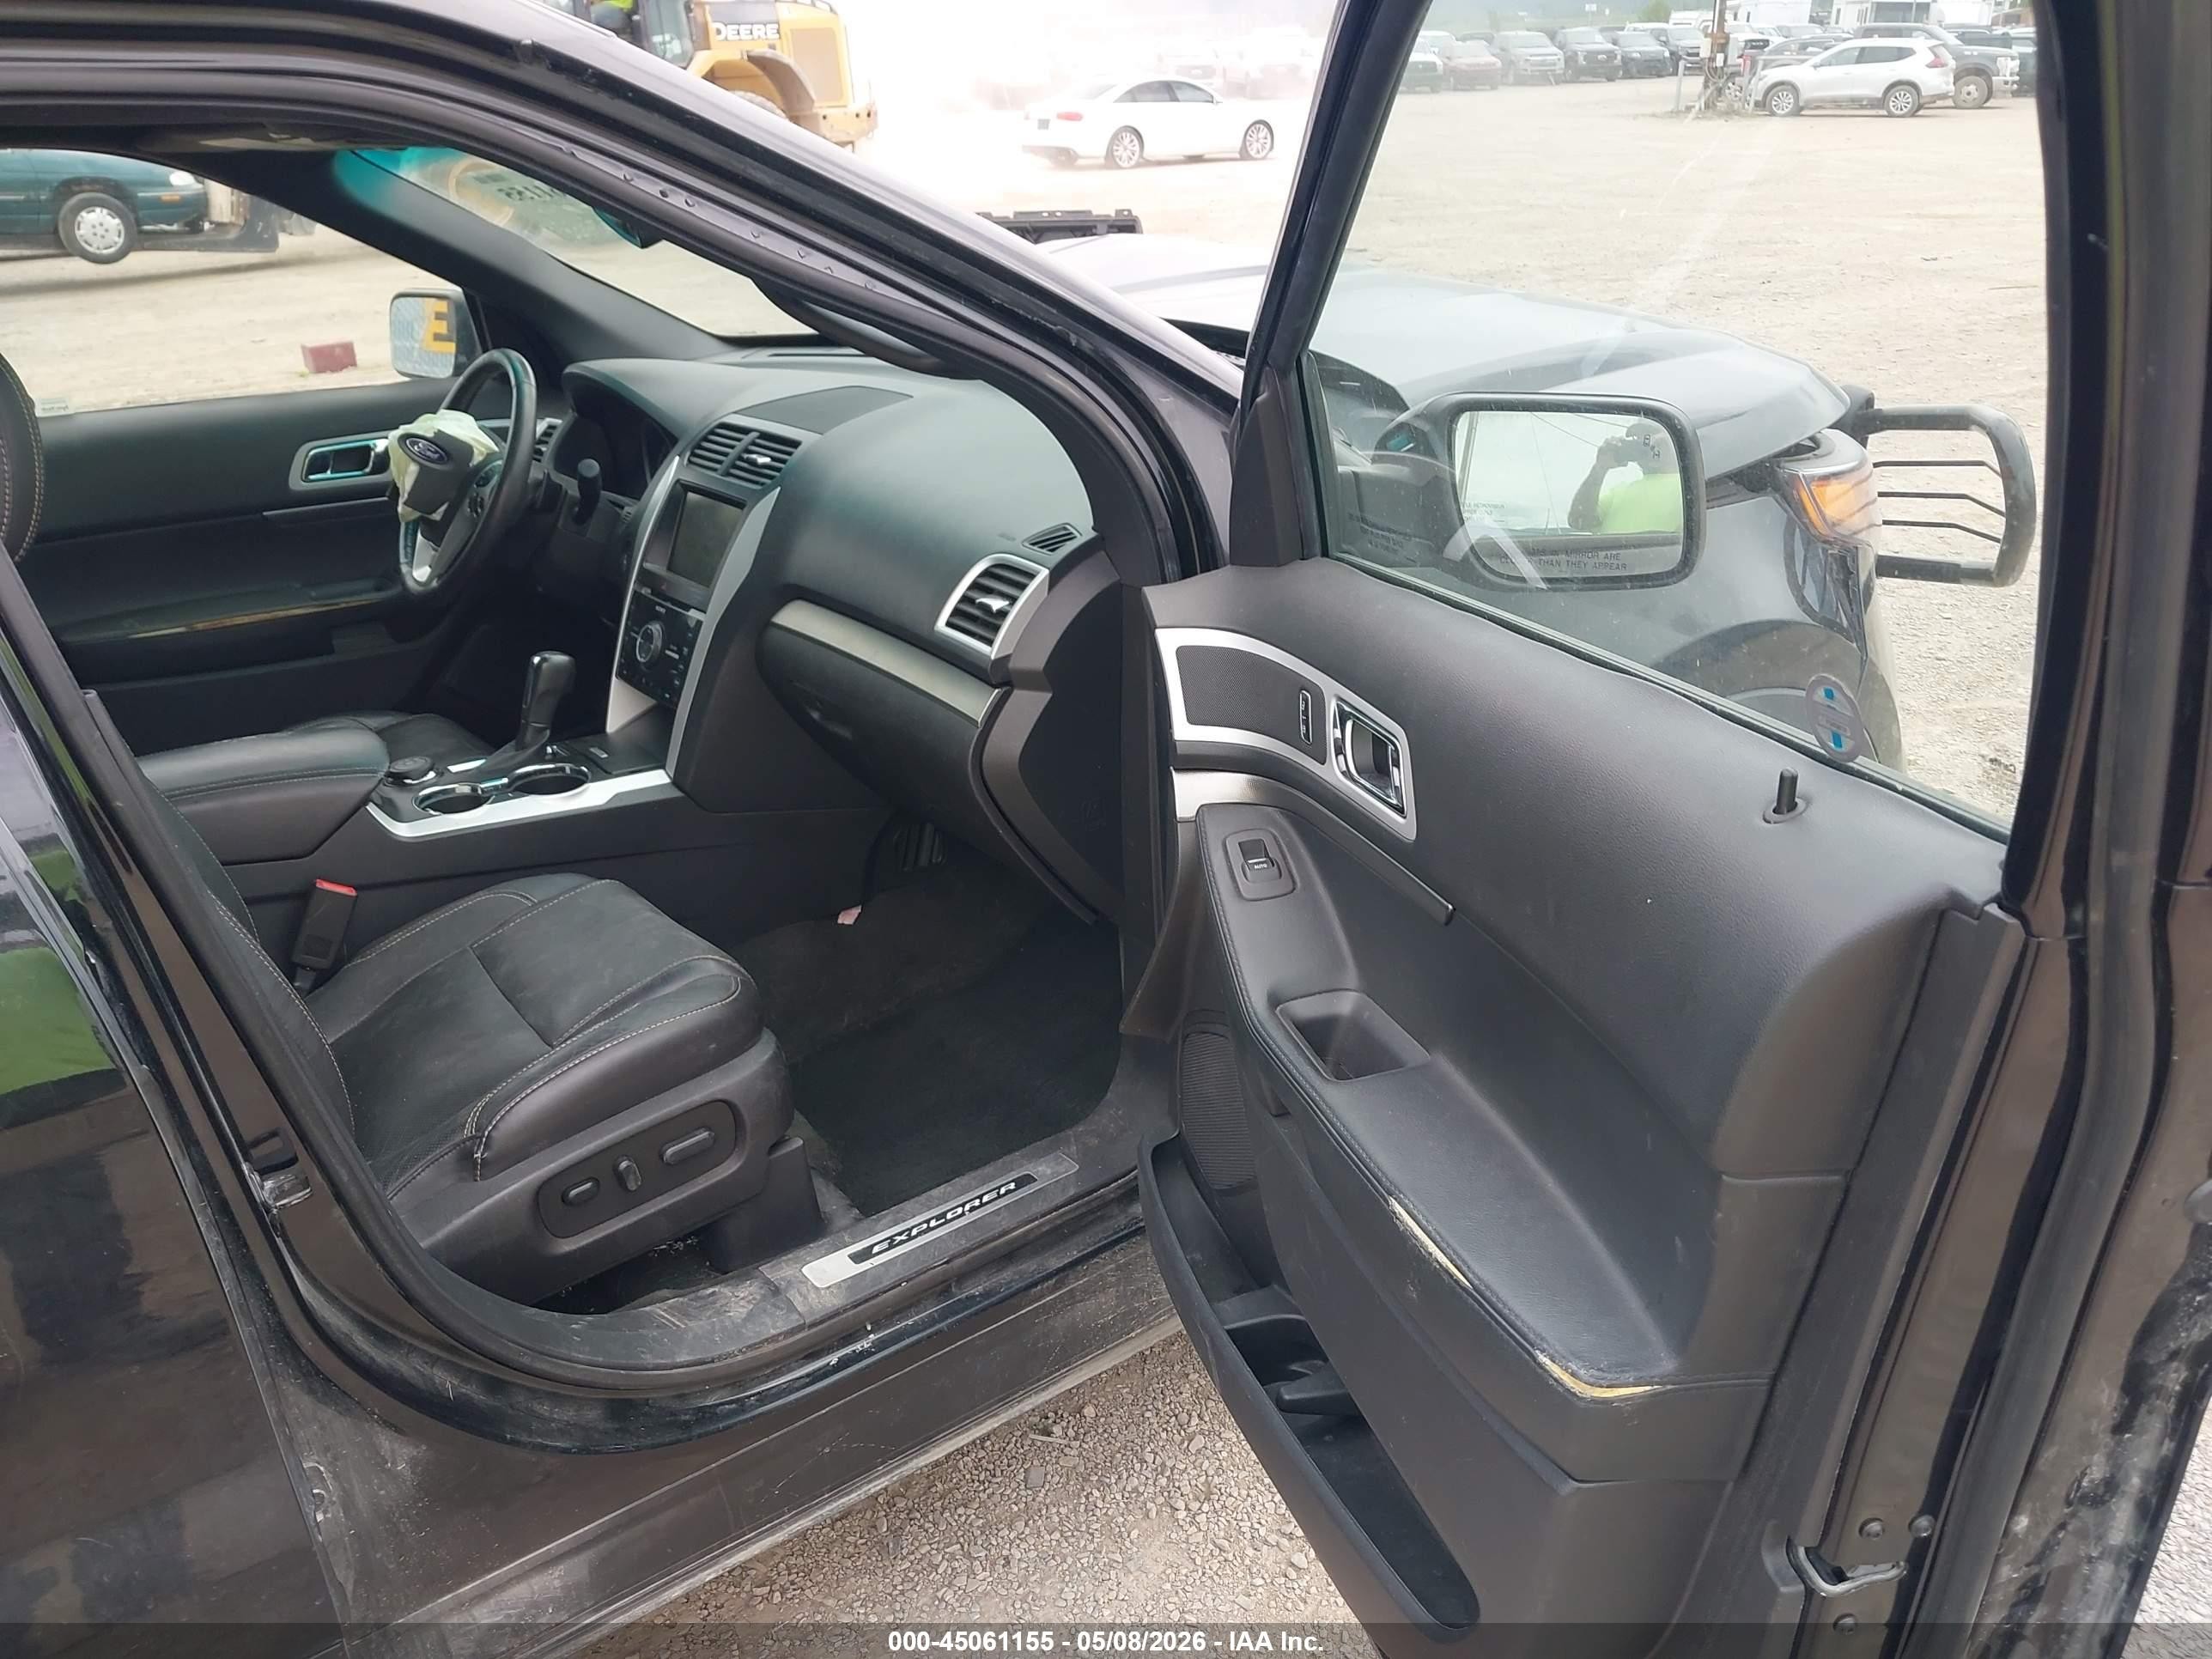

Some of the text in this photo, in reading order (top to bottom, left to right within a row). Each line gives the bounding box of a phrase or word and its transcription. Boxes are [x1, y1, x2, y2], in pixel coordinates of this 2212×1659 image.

[711, 22, 780, 41] DEERE
[1538, 557, 1561, 568] THAN
[1565, 559, 1589, 568] THEY
[1592, 562, 1628, 571] APPEAR
[1603, 552, 1622, 561] ARE
[871, 1181, 1018, 1255] EXPLORER
